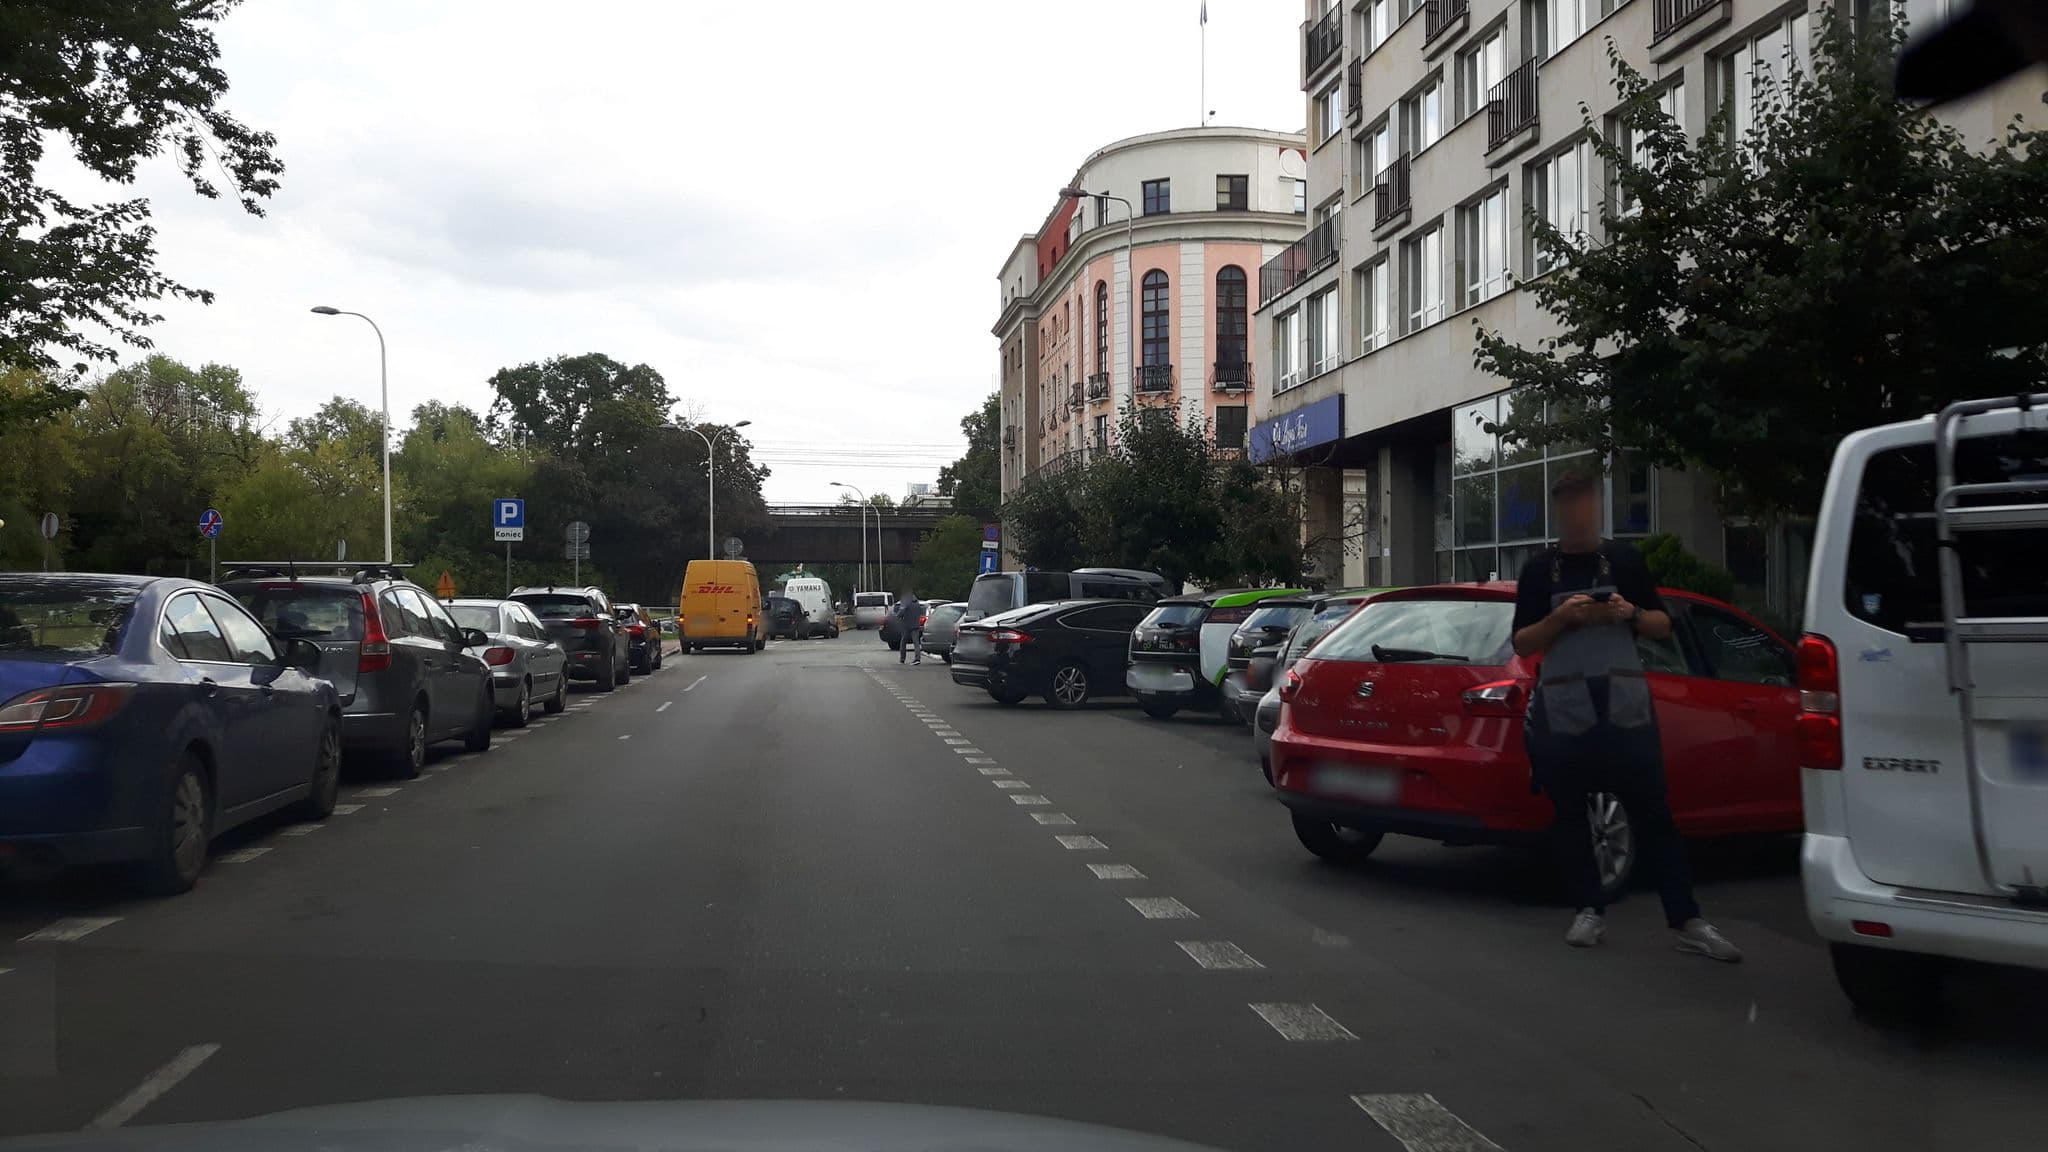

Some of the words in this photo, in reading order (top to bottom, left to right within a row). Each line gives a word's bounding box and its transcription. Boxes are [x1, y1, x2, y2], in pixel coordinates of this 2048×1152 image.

[501, 502, 518, 525] P
[495, 530, 522, 538] Koniec
[698, 586, 734, 594] DHL
[797, 584, 822, 593] YAMAHA
[1862, 757, 1942, 775] EXPERT
